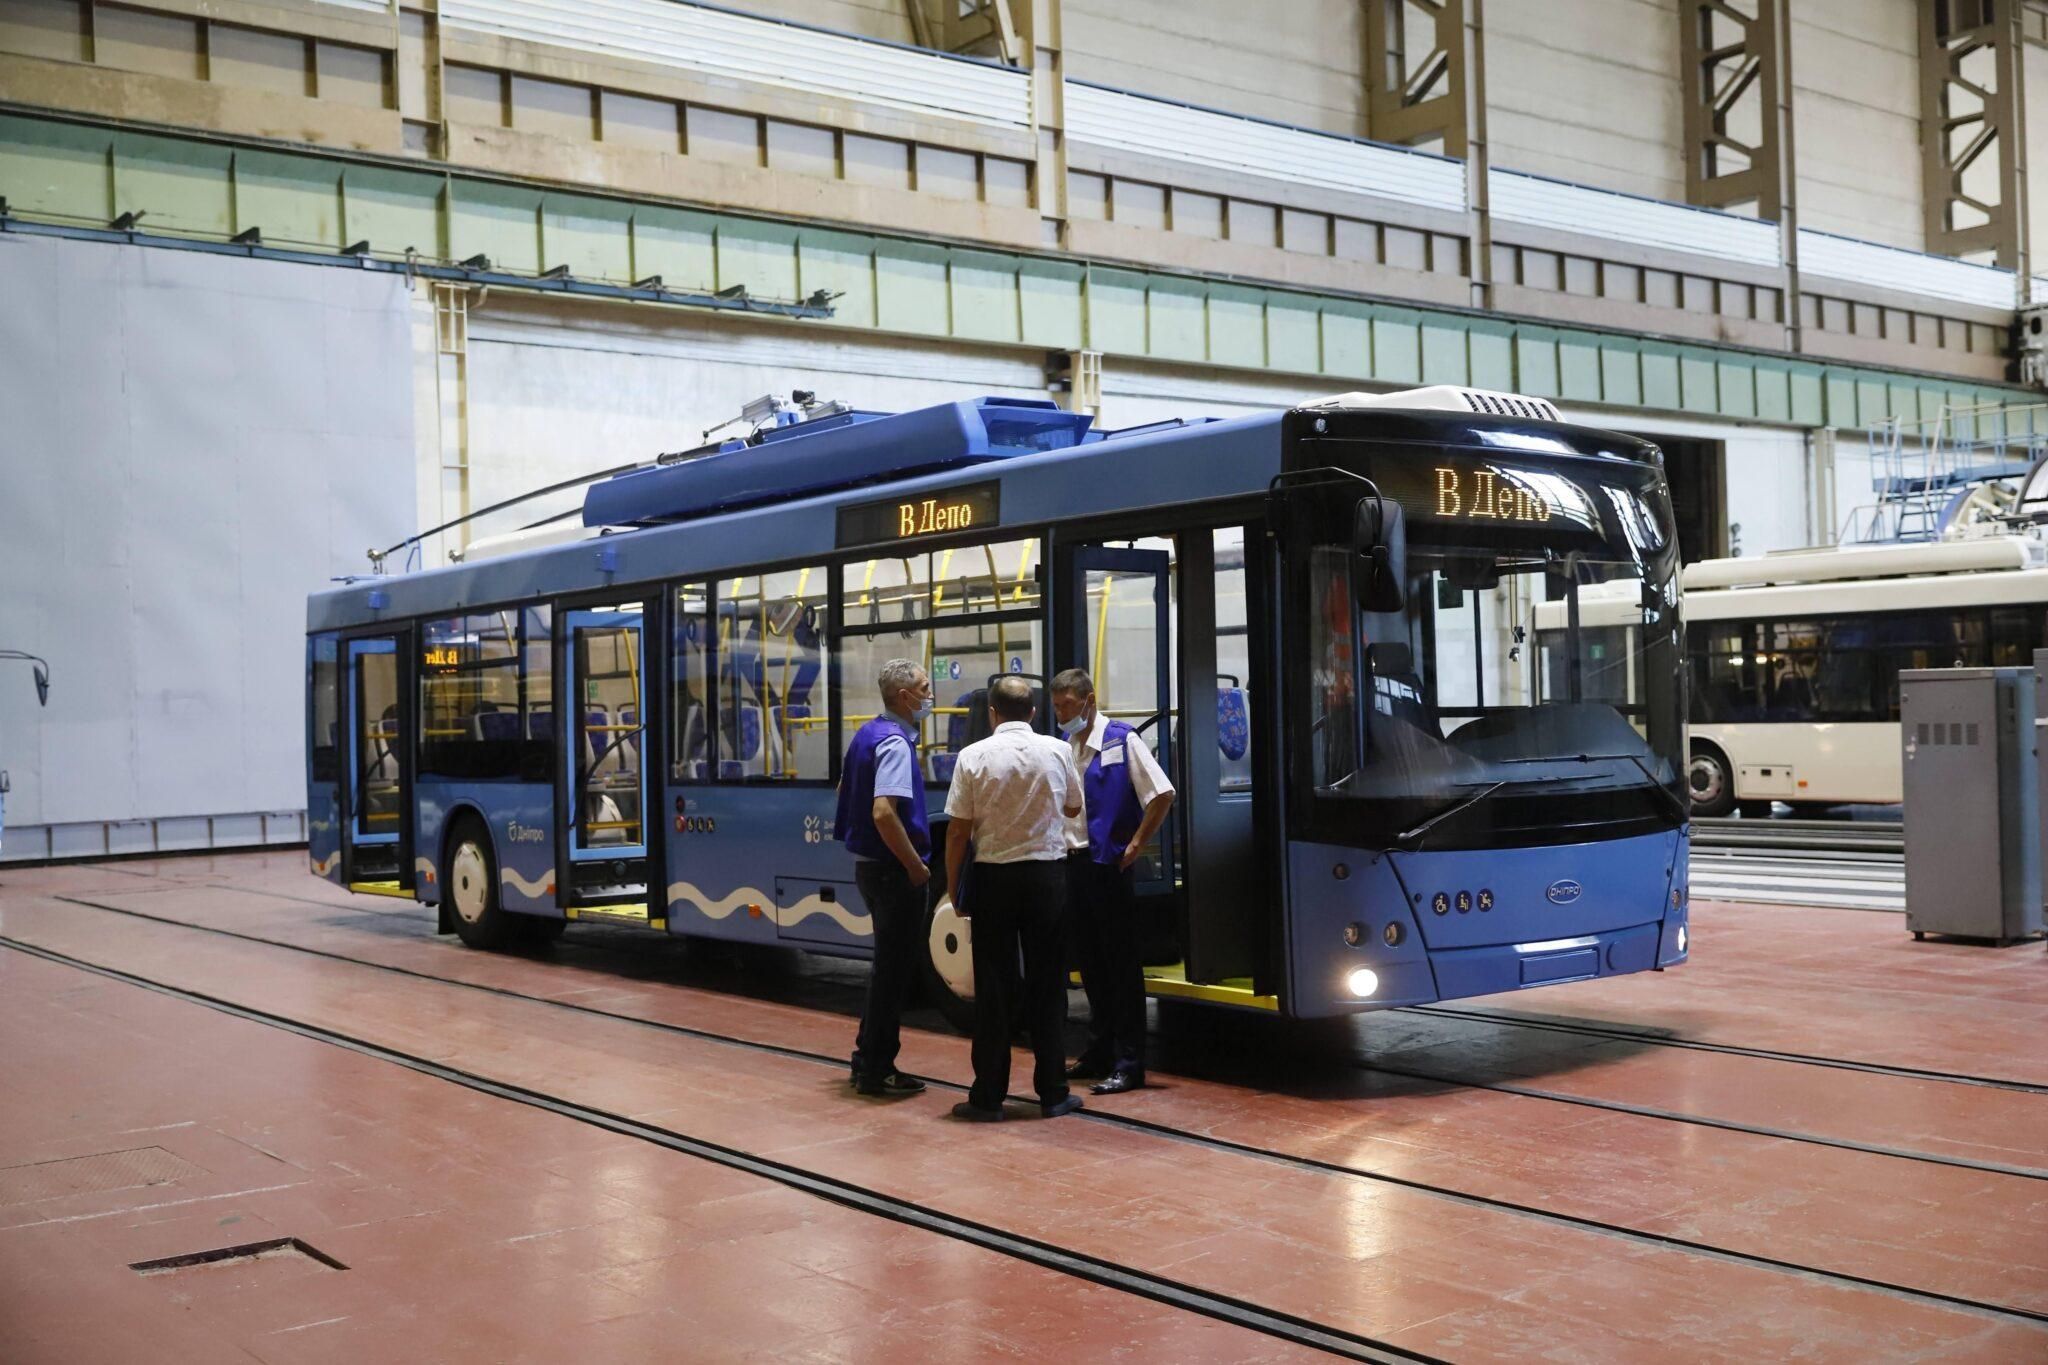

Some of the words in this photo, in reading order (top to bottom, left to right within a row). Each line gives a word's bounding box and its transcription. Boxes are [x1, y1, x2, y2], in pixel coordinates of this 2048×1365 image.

[1434, 467, 1461, 516] В
[899, 503, 915, 536] В
[918, 500, 972, 533] Депо
